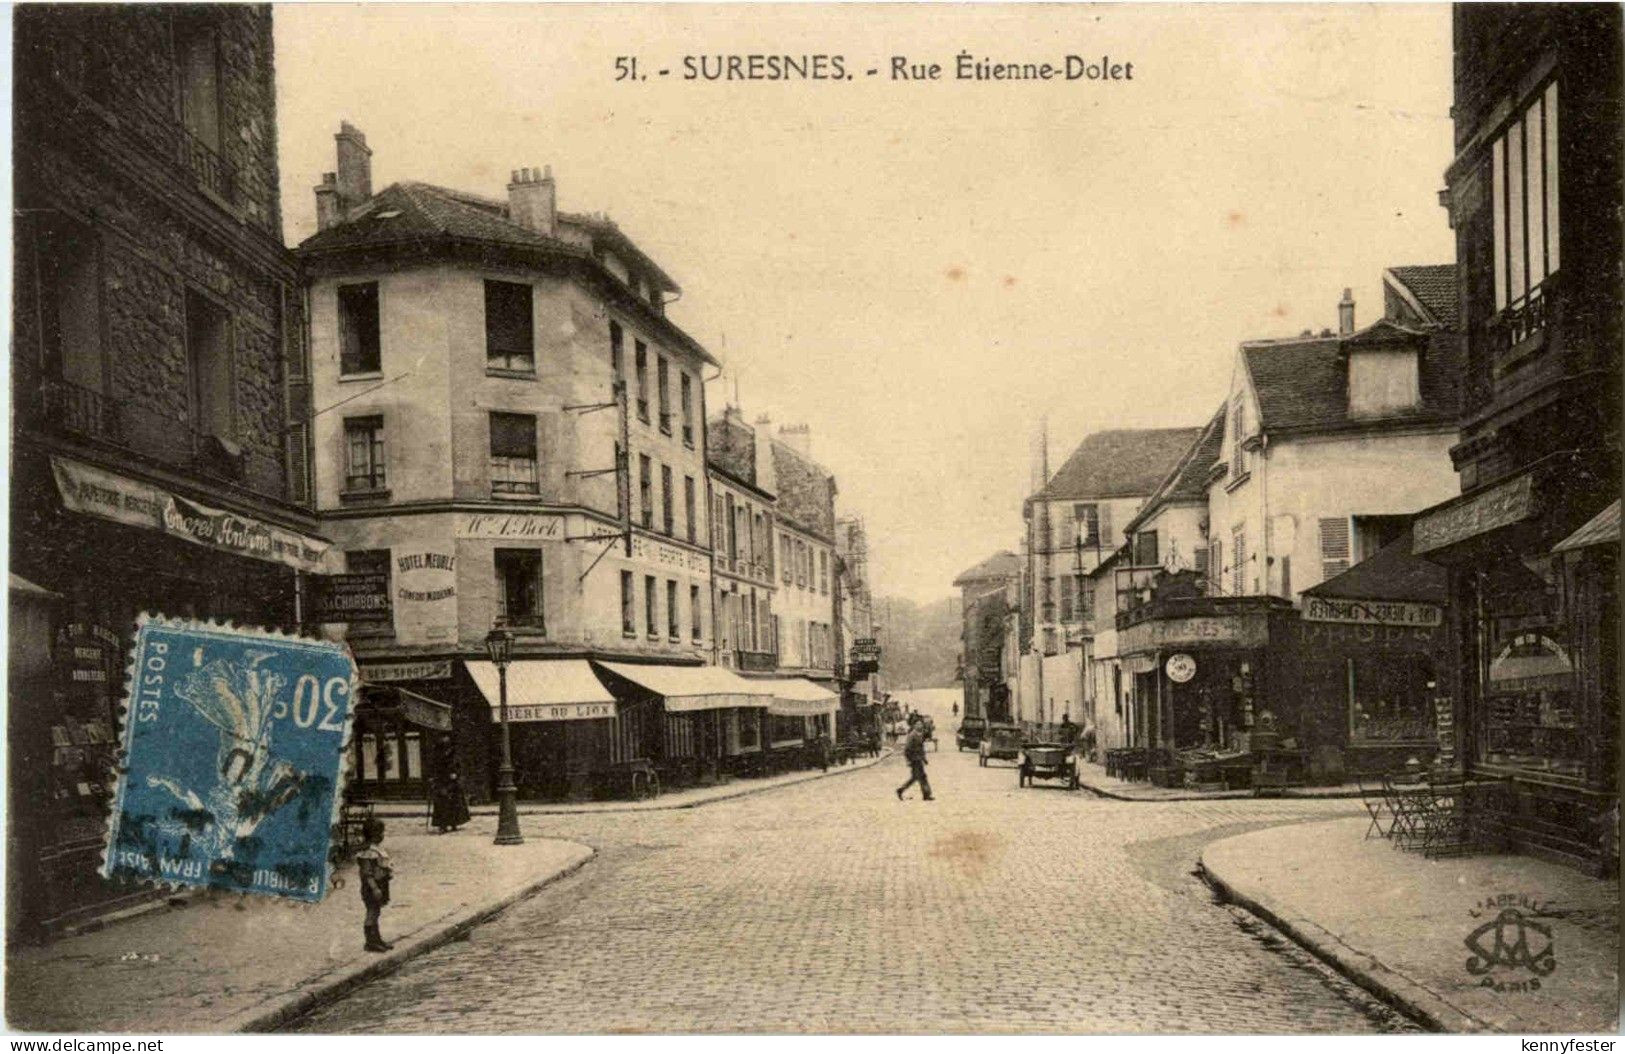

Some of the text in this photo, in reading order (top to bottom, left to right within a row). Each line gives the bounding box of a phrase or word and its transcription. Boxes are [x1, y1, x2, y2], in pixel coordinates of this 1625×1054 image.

[397, 555, 423, 574] HOTEL
[138, 642, 168, 723] POSTES
[293, 673, 348, 733] 30
